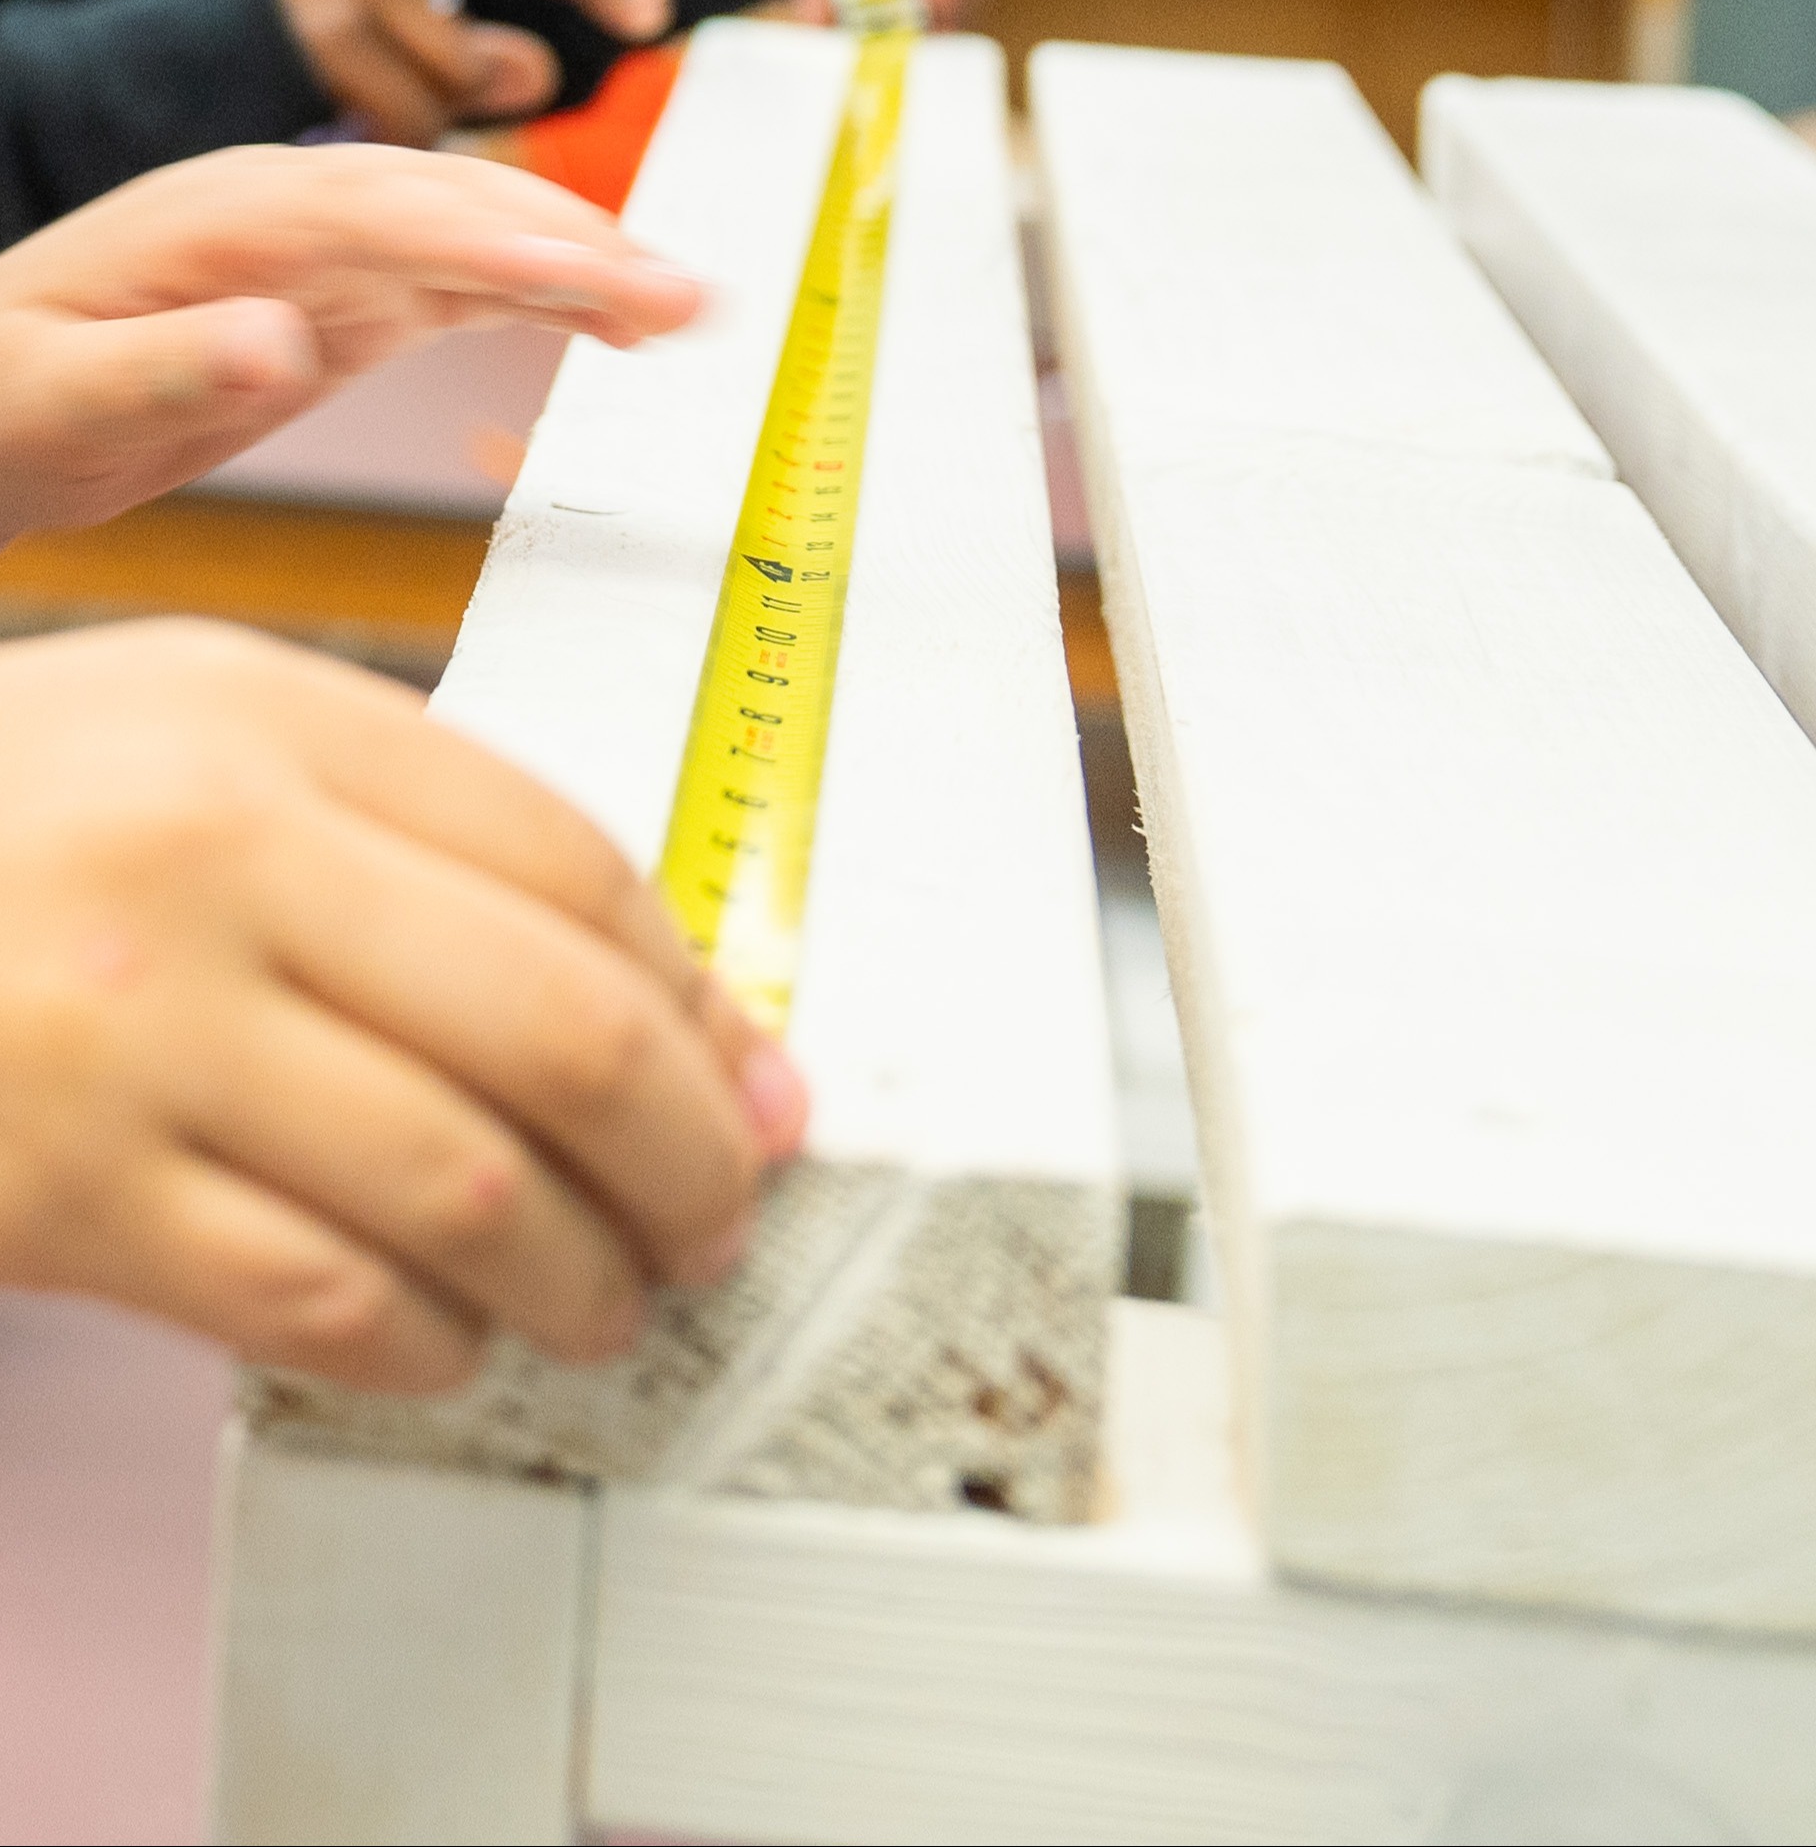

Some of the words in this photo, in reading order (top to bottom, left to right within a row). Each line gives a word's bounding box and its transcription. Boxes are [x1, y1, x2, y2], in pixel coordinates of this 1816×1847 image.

[800, 571, 831, 582] 12
[760, 594, 802, 614] 11
[754, 625, 798, 647] 10
[747, 669, 790, 686] 9
[739, 707, 783, 725] 8
[730, 745, 777, 763] 7
